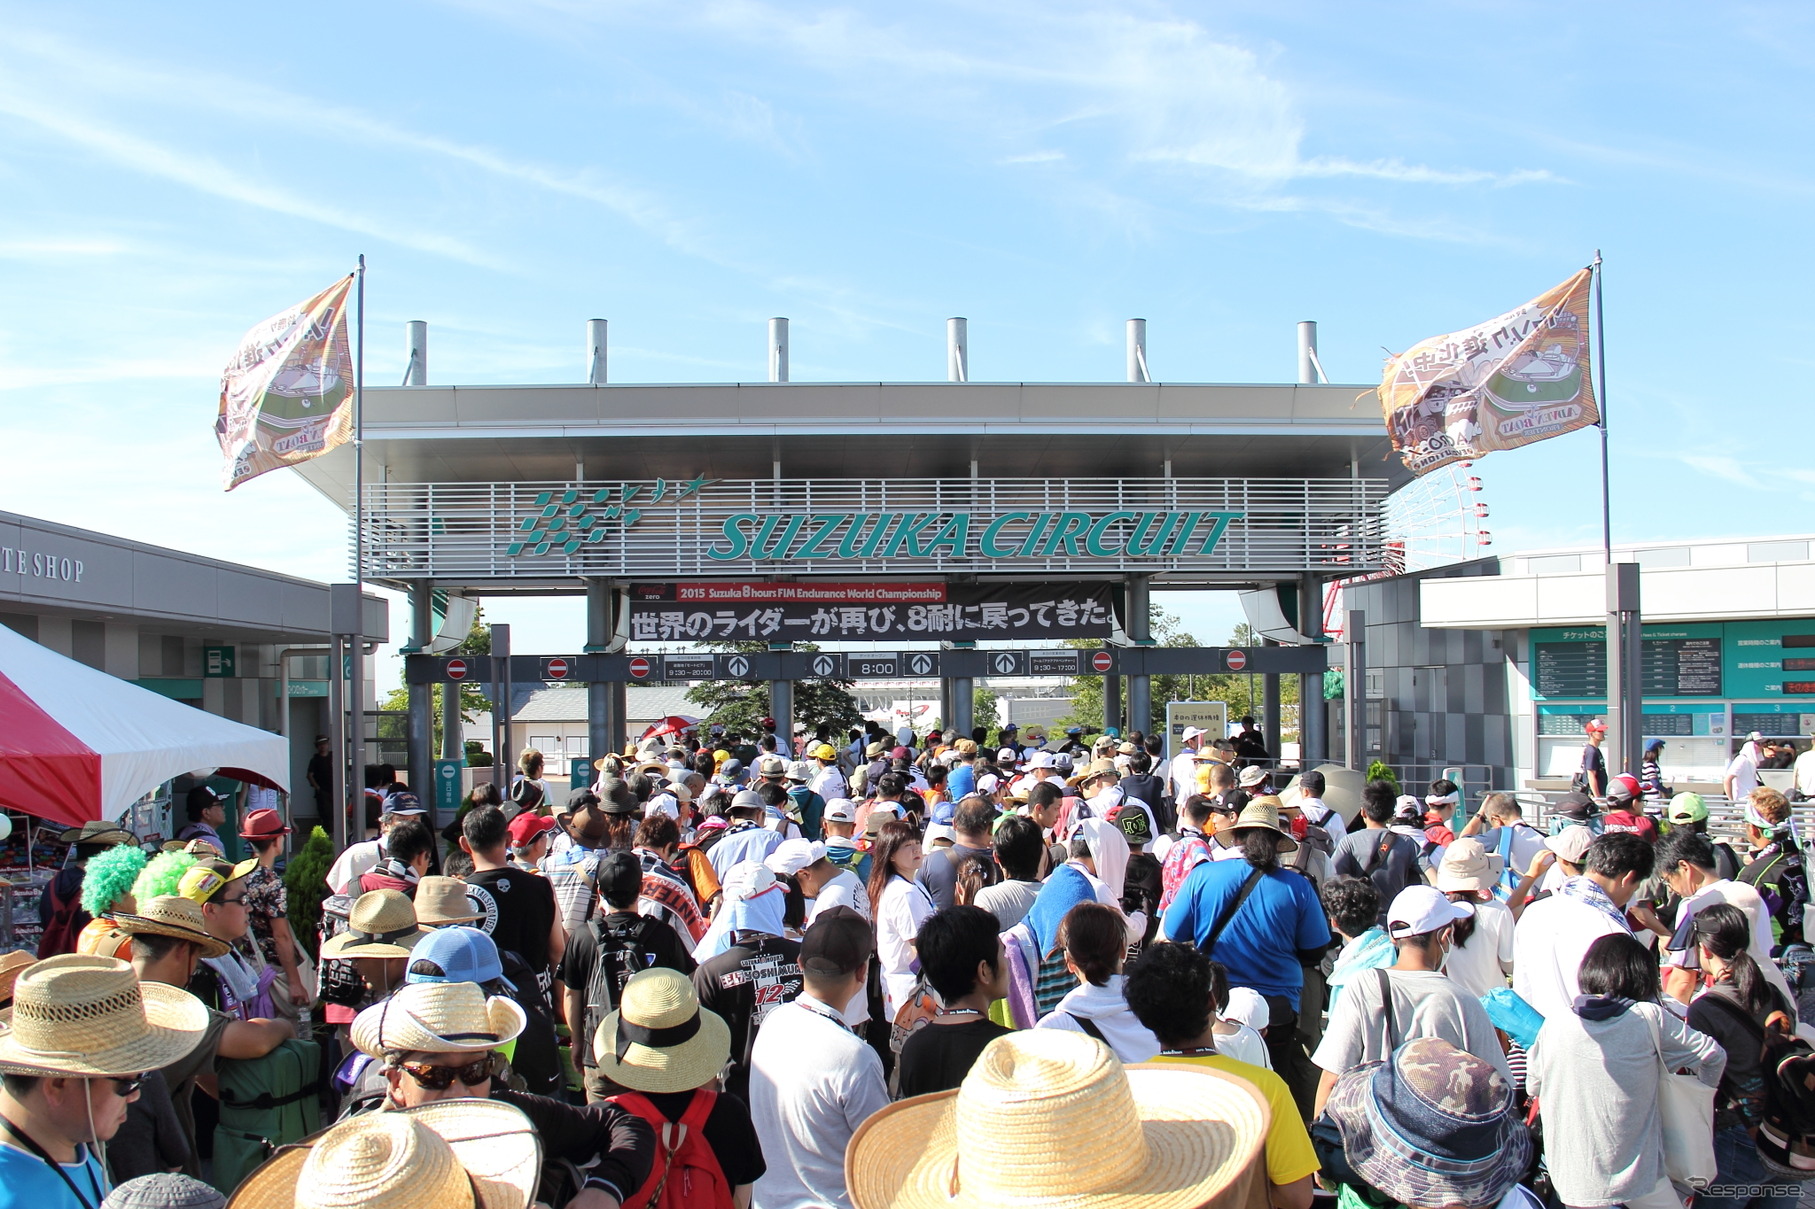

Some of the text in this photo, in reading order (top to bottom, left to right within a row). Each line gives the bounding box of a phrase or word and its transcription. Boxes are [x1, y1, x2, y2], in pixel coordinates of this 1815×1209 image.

[706, 511, 1246, 560] SUZUKA CIRCUIT
[33, 553, 84, 583] SHOP
[680, 585, 942, 600] 2015 Suzuka 8 hours FIM Endurance World Championship
[1562, 631, 1607, 640] チケットのご
[861, 663, 894, 674] 8:00
[744, 964, 803, 980] YOSHIMUR
[754, 984, 785, 1006] 12
